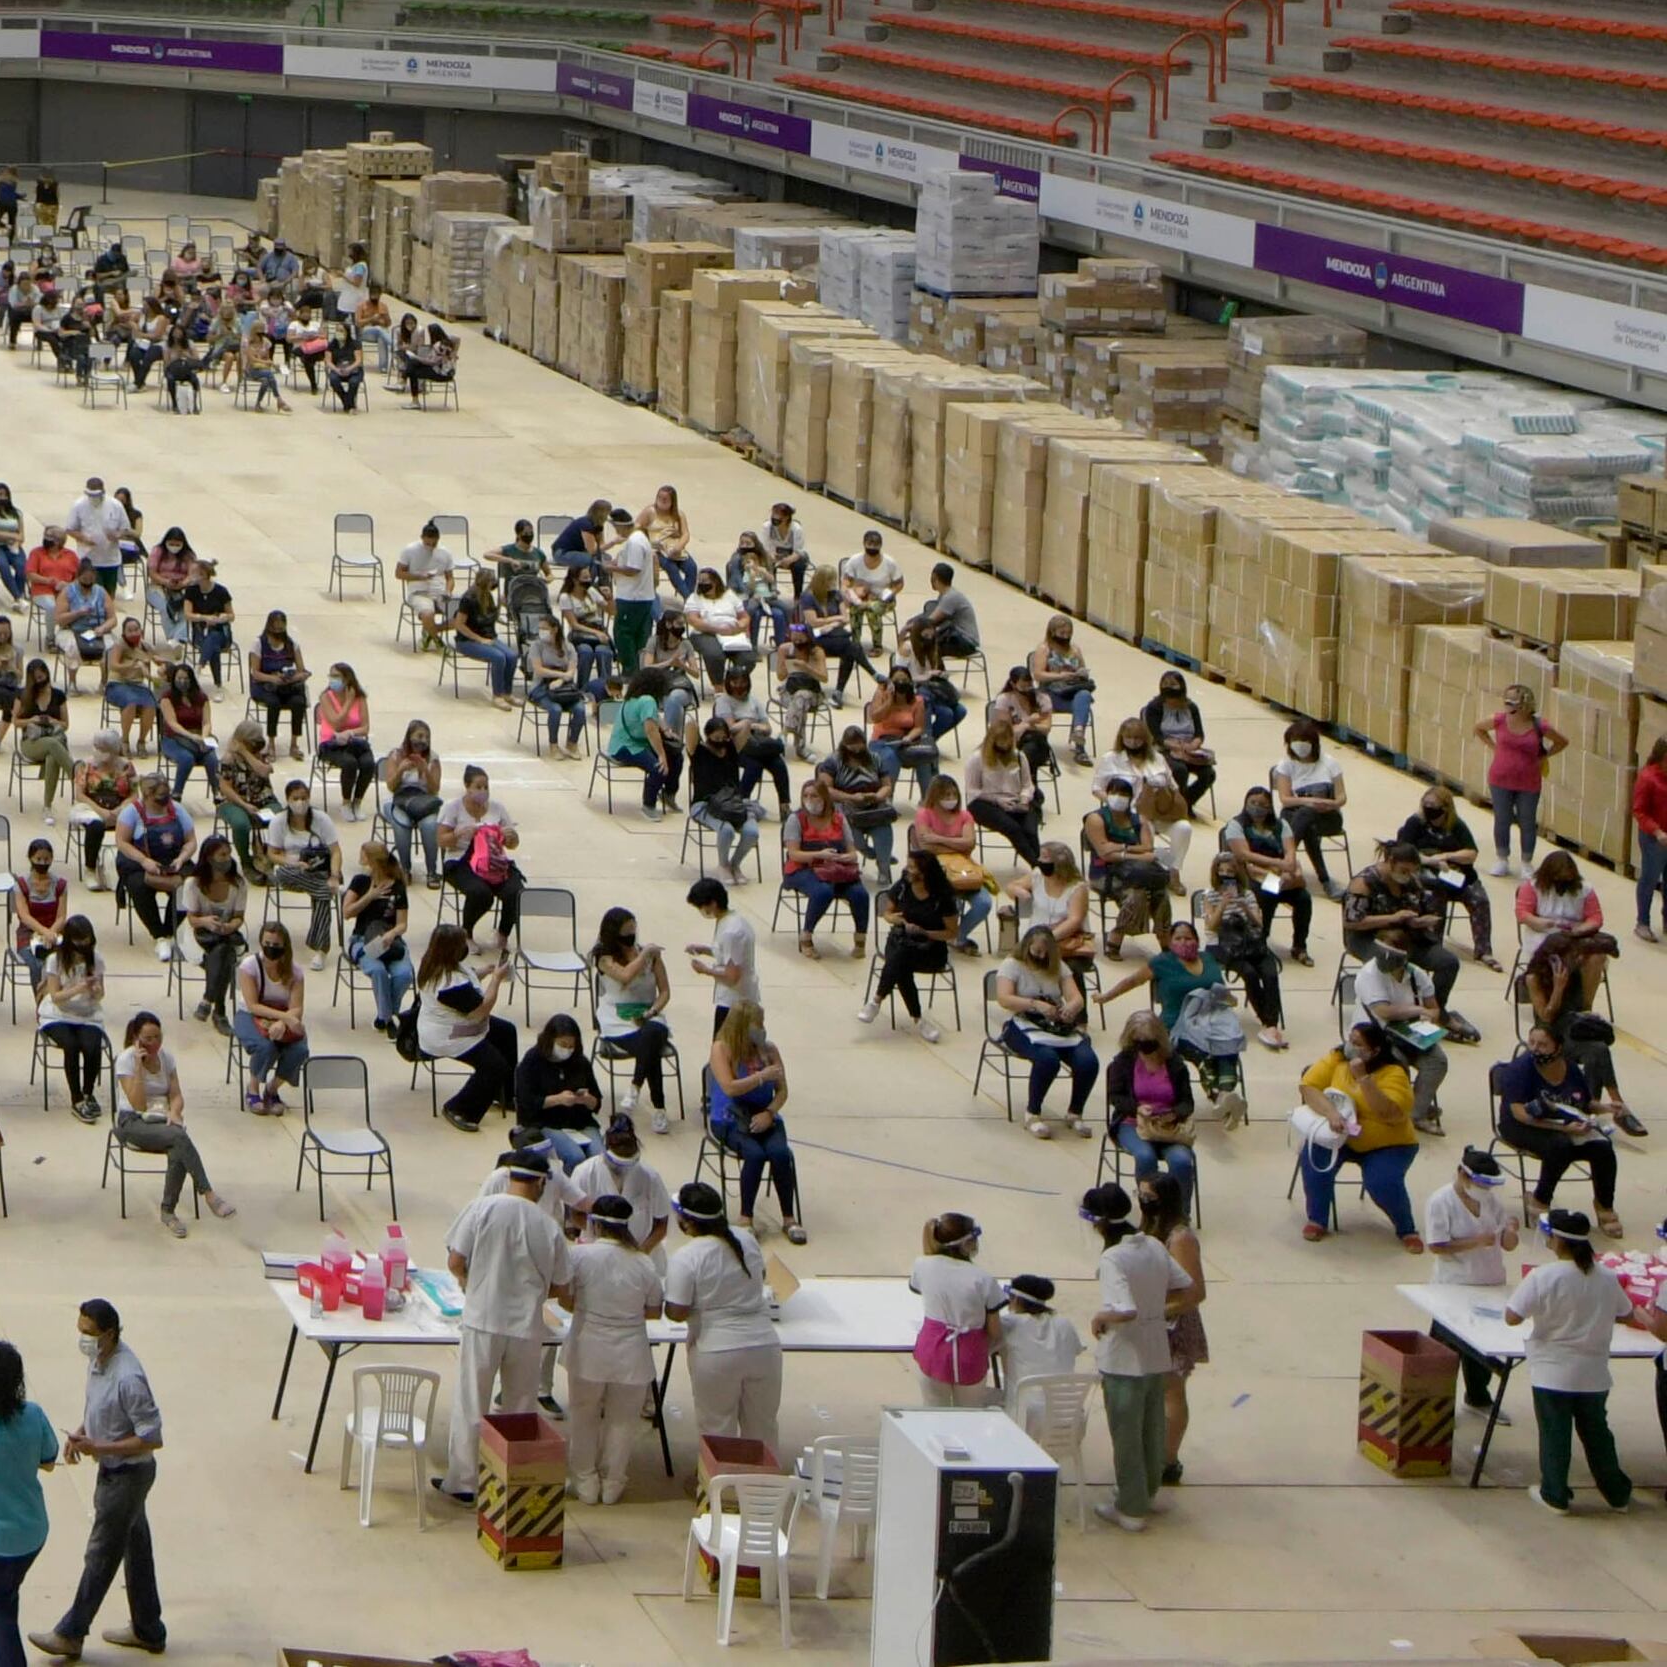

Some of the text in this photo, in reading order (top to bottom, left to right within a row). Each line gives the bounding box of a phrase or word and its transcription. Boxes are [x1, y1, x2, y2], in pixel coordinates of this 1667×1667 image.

[426, 59, 471, 70] MENDOZA
[1002, 177, 1038, 197] ARGENTINA
[1149, 207, 1189, 226] MENDOZA
[1325, 256, 1446, 297] MENDOZA ARGENTINA
